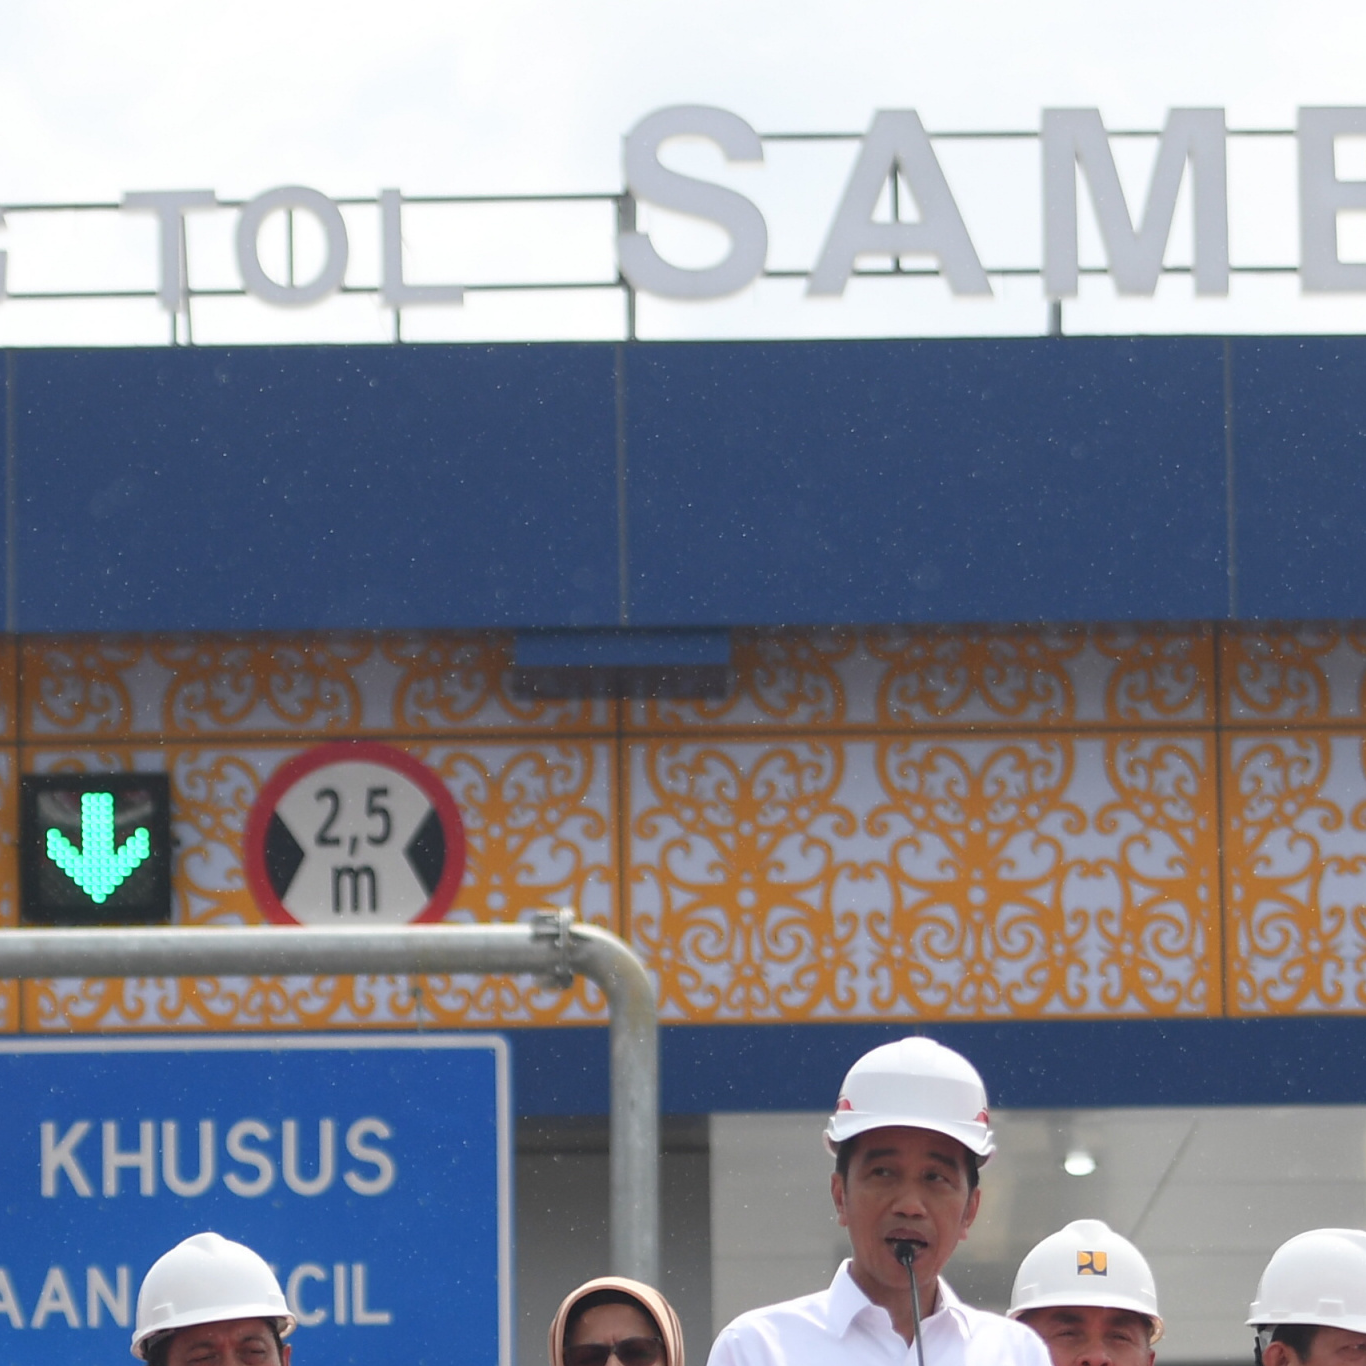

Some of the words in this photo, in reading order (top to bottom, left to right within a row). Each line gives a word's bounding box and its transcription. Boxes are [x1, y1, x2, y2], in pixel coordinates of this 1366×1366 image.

[120, 185, 464, 312] TOL
[316, 786, 392, 856] 2,5
[331, 863, 377, 913] m
[40, 1117, 395, 1198] KHUSUS
